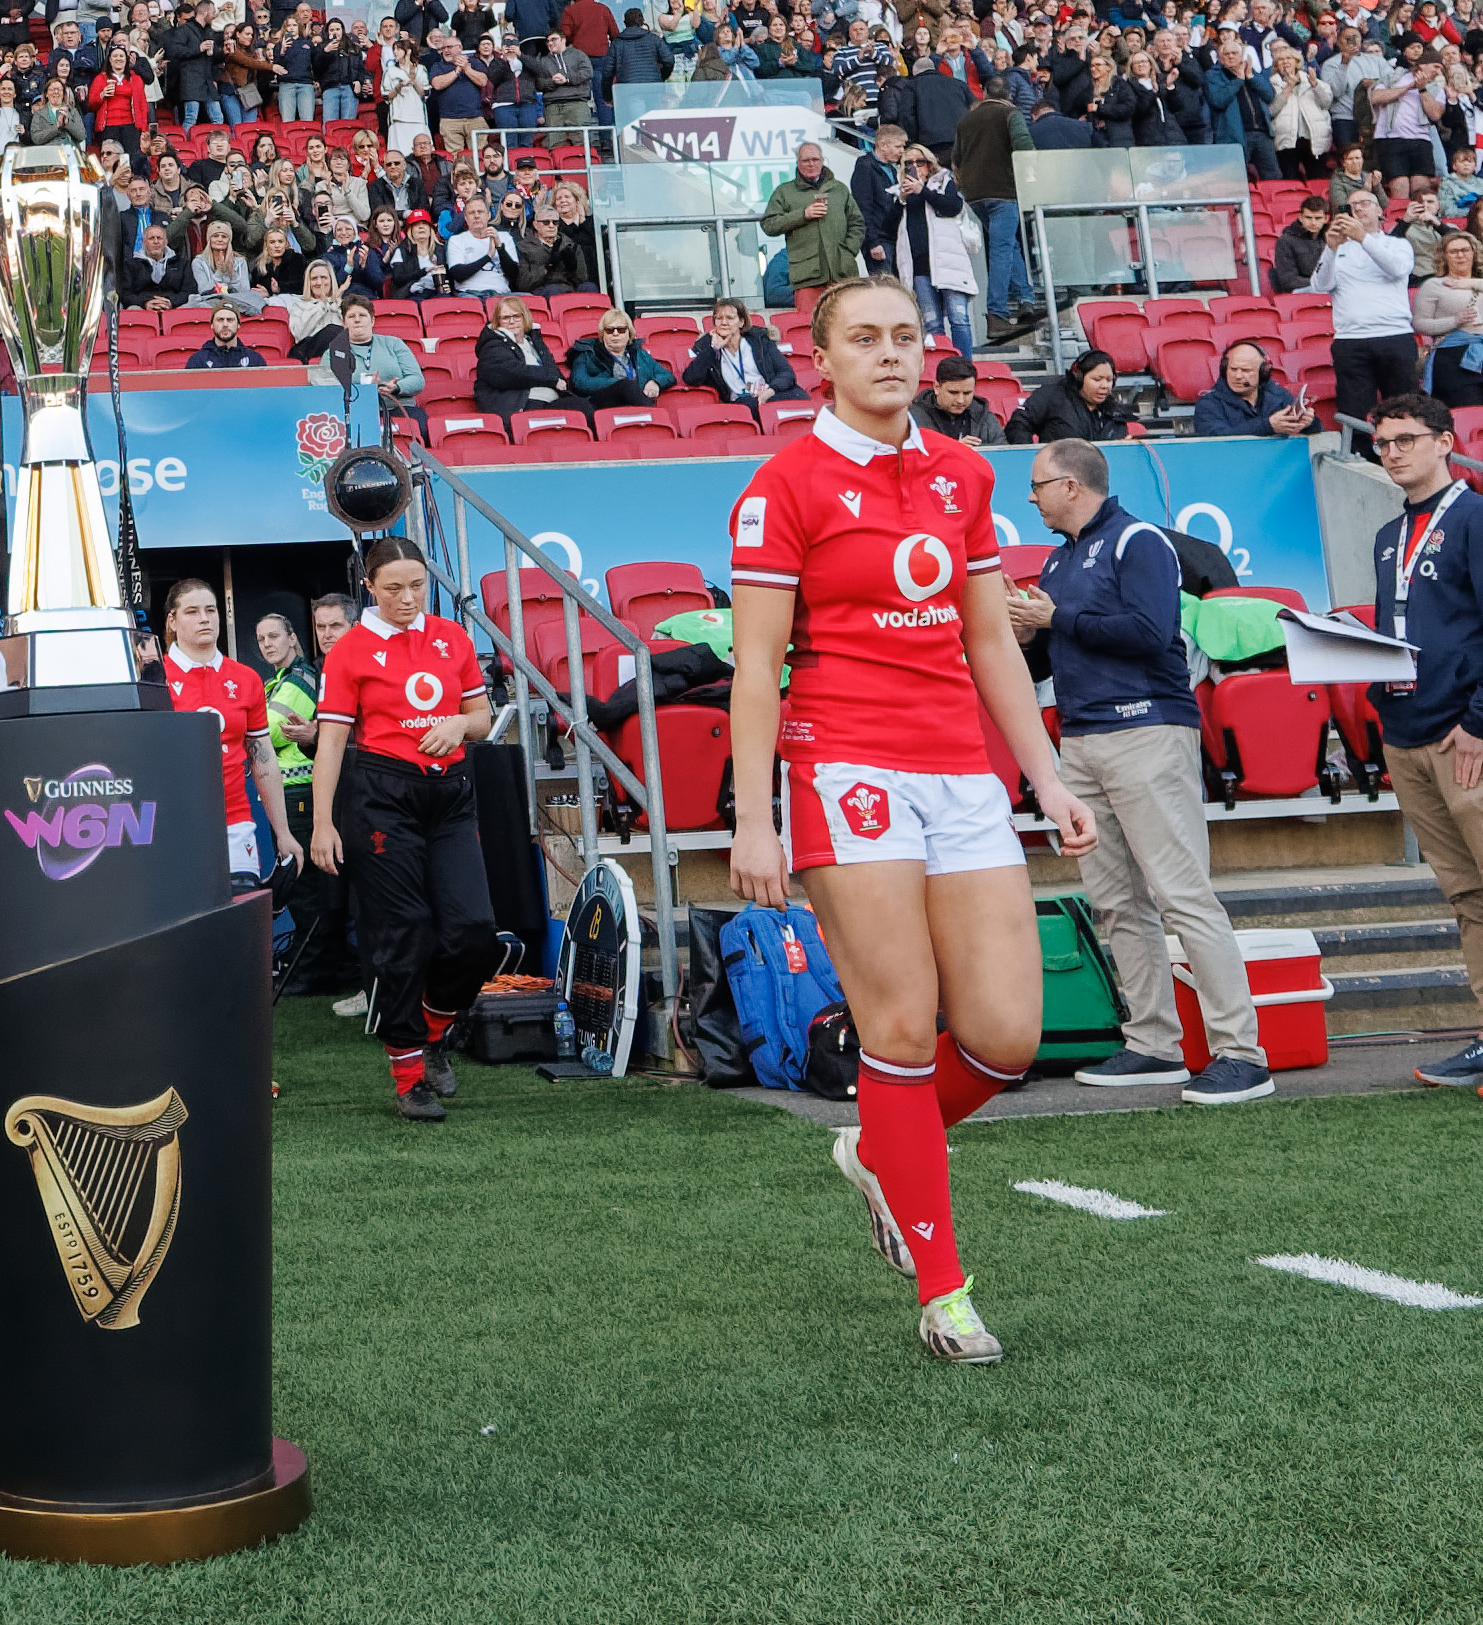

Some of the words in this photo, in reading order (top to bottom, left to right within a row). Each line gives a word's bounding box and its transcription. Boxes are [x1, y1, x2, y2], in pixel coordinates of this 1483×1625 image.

[652, 131, 721, 160] W14
[741, 129, 806, 157] W13
[1175, 502, 1253, 576] O2
[399, 714, 454, 729] vodafon
[44, 779, 134, 798] GUINNESS
[67, 1252, 99, 1298] 1759
